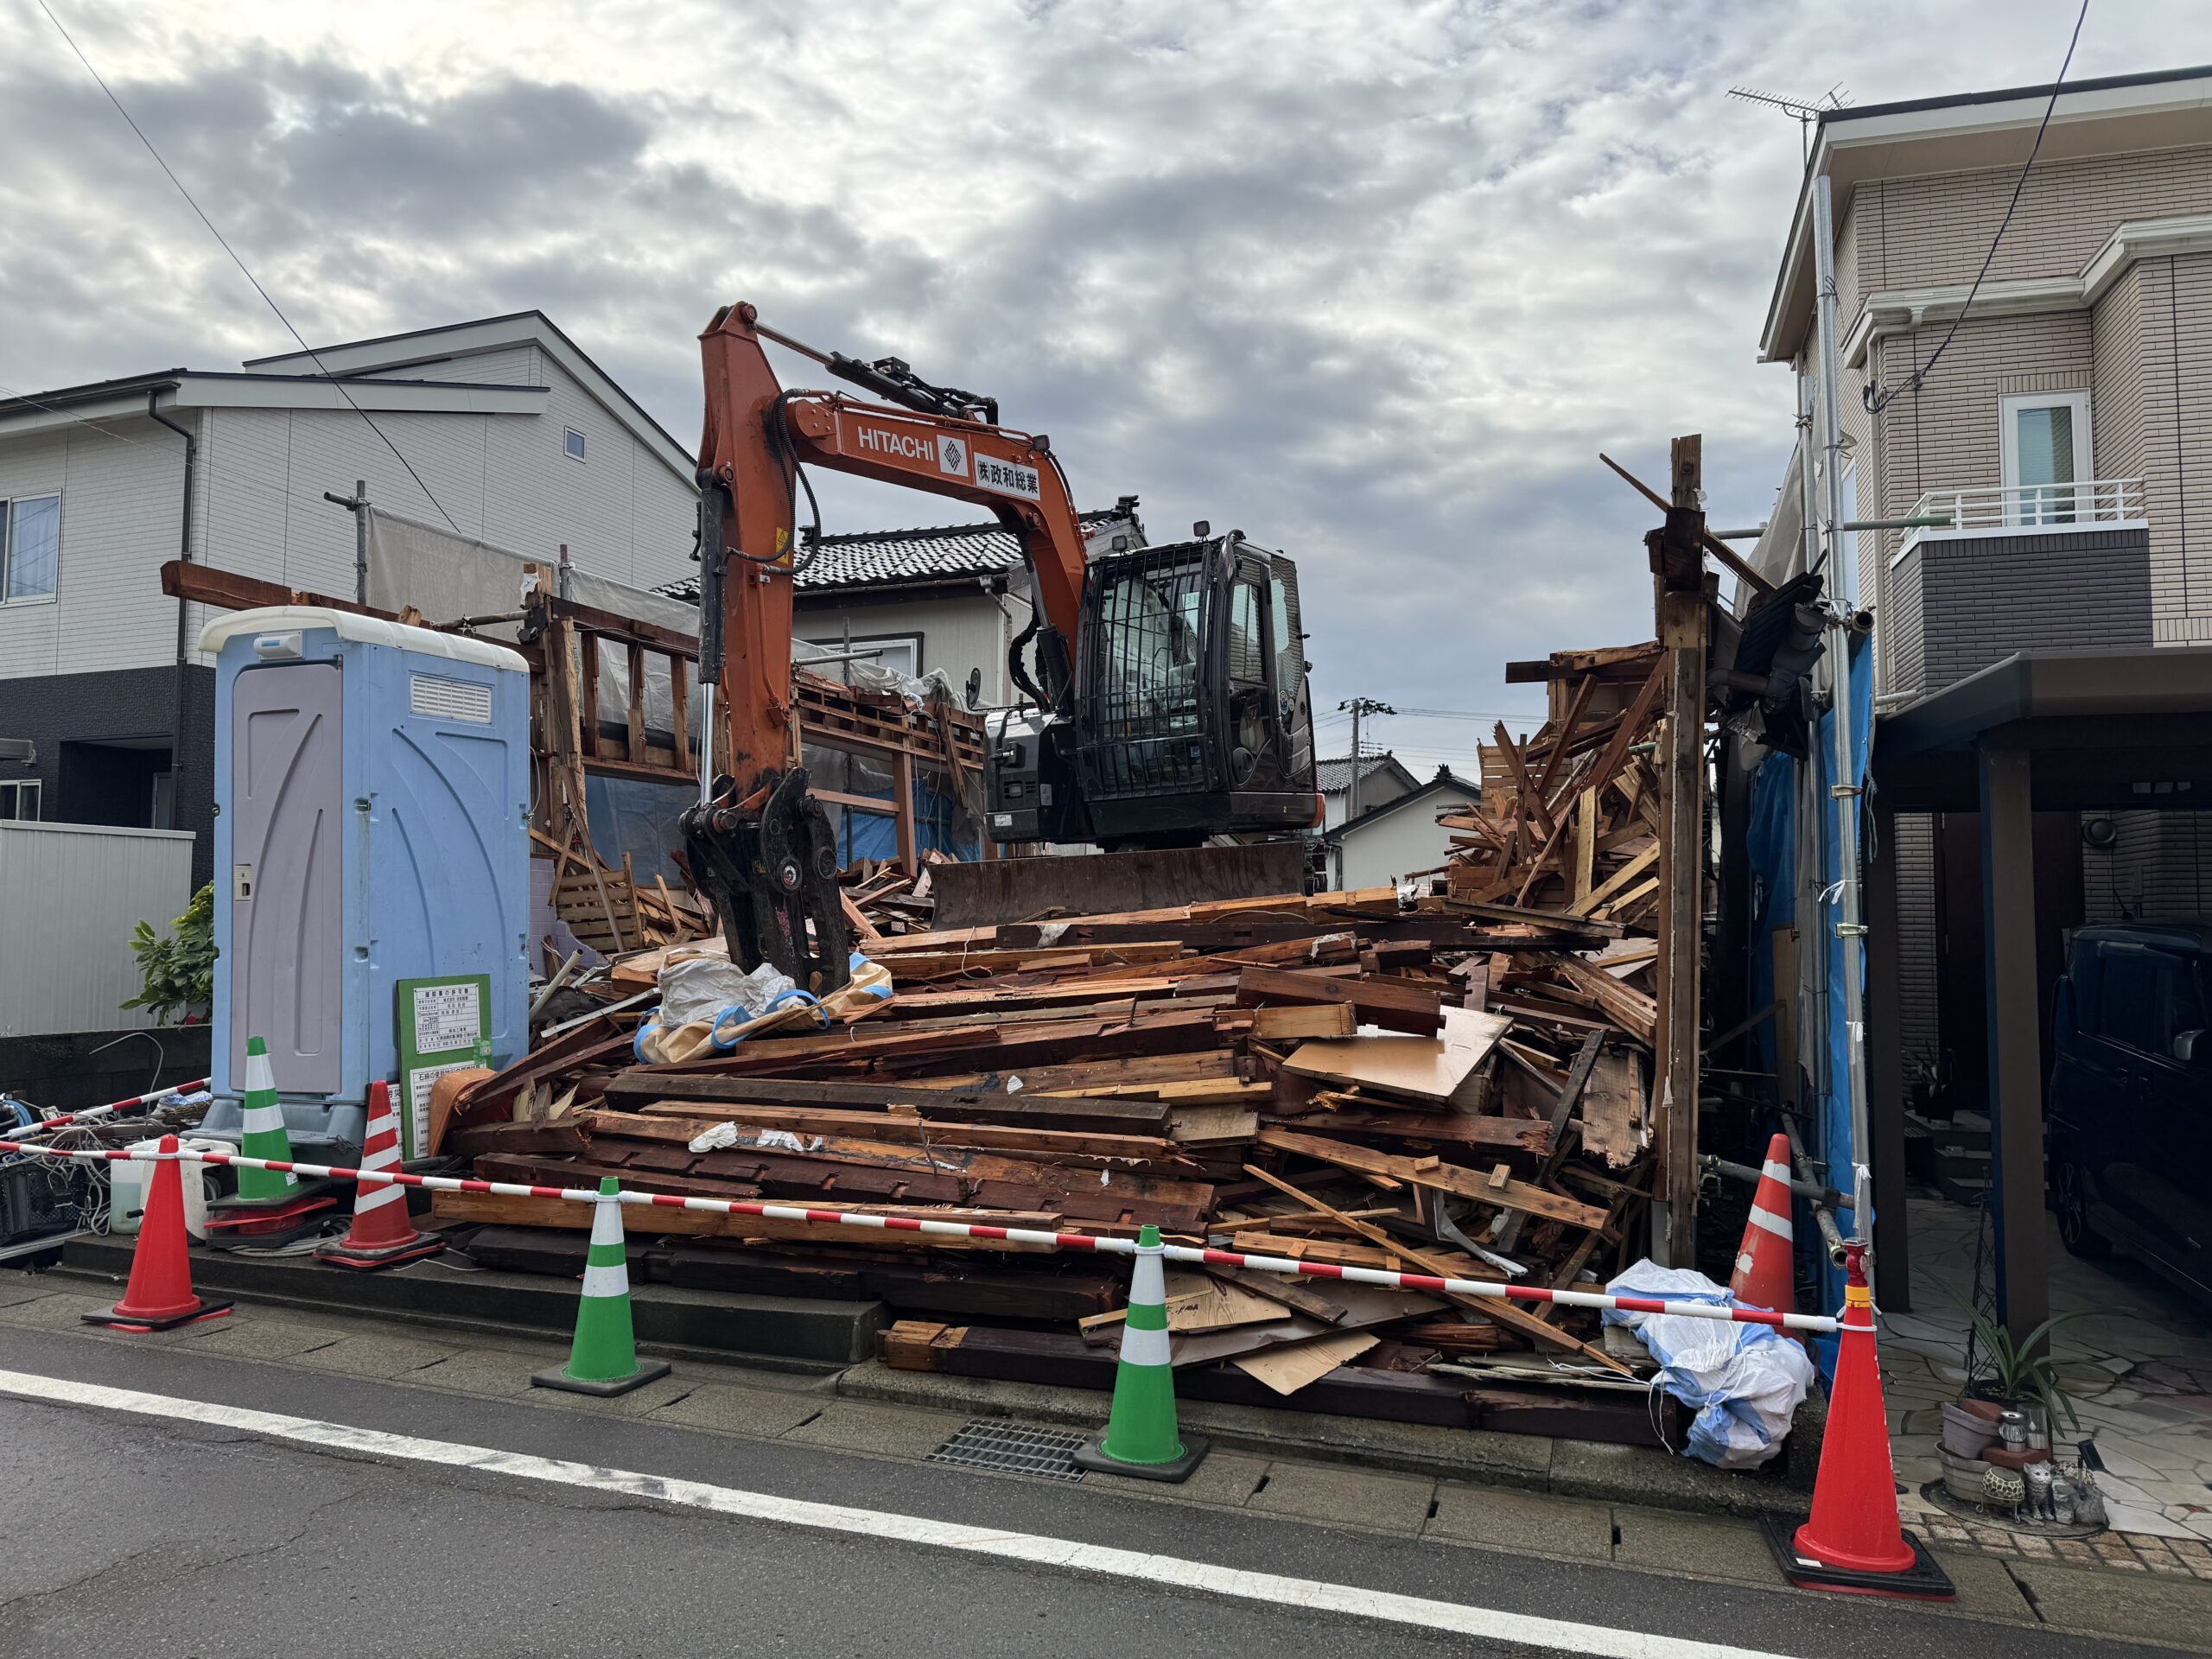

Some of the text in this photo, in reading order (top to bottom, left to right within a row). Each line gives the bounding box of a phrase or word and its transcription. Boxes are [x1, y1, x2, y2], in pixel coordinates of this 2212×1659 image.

[858, 426, 933, 461] HITACHI
[978, 460, 1038, 493] (株)政和総業
